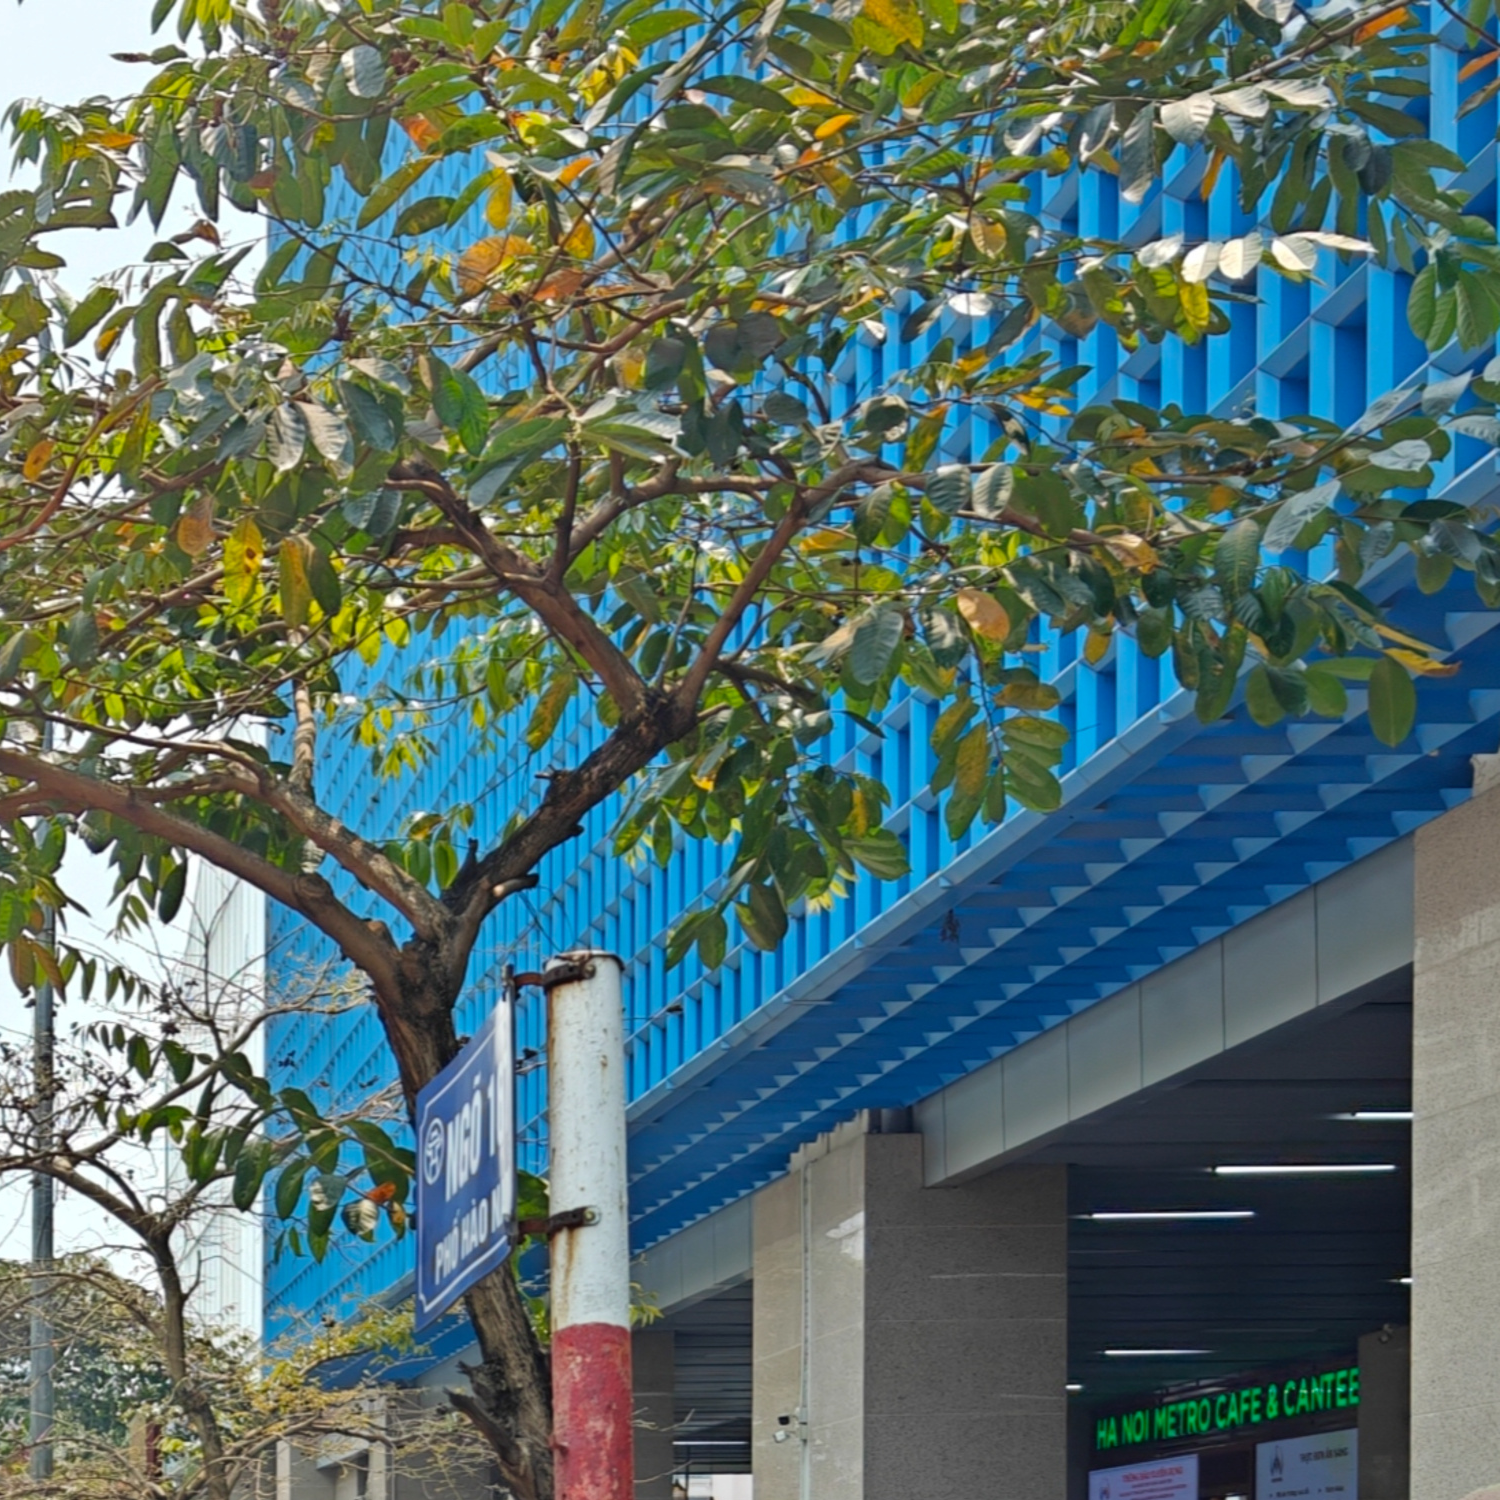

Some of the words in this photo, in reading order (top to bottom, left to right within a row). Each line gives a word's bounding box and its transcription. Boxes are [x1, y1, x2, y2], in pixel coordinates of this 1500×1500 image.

[1097, 1416, 1118, 1449] HA
[1121, 1409, 1150, 1445] NOI
[1154, 1398, 1211, 1440] METRO
[1215, 1387, 1262, 1429] CAFE
[1266, 1383, 1278, 1419] &
